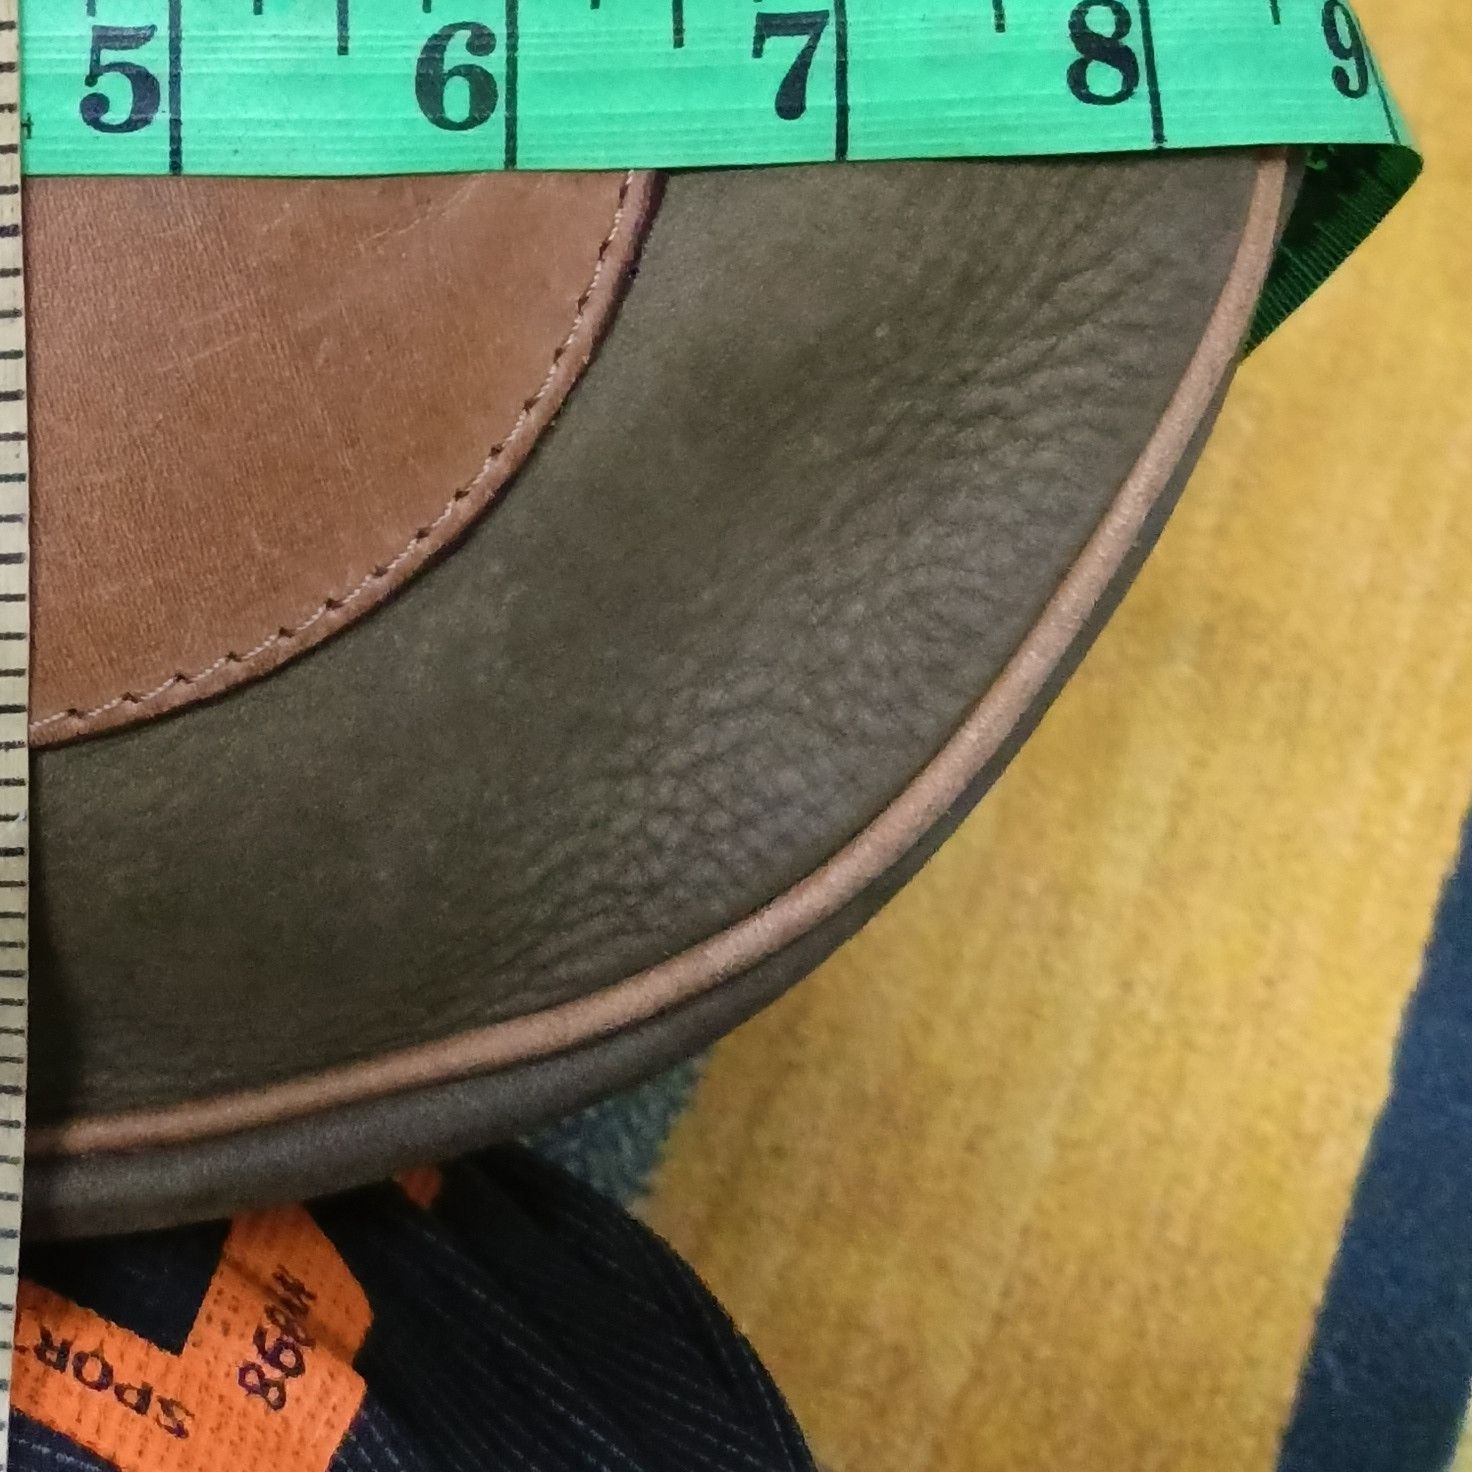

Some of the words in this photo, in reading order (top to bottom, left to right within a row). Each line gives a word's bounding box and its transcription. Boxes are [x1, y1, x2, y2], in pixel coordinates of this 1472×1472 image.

[79, 25, 160, 134] 5
[414, 22, 499, 131] 6
[753, 11, 829, 121] 7
[16, 1326, 195, 1439] SPOR
